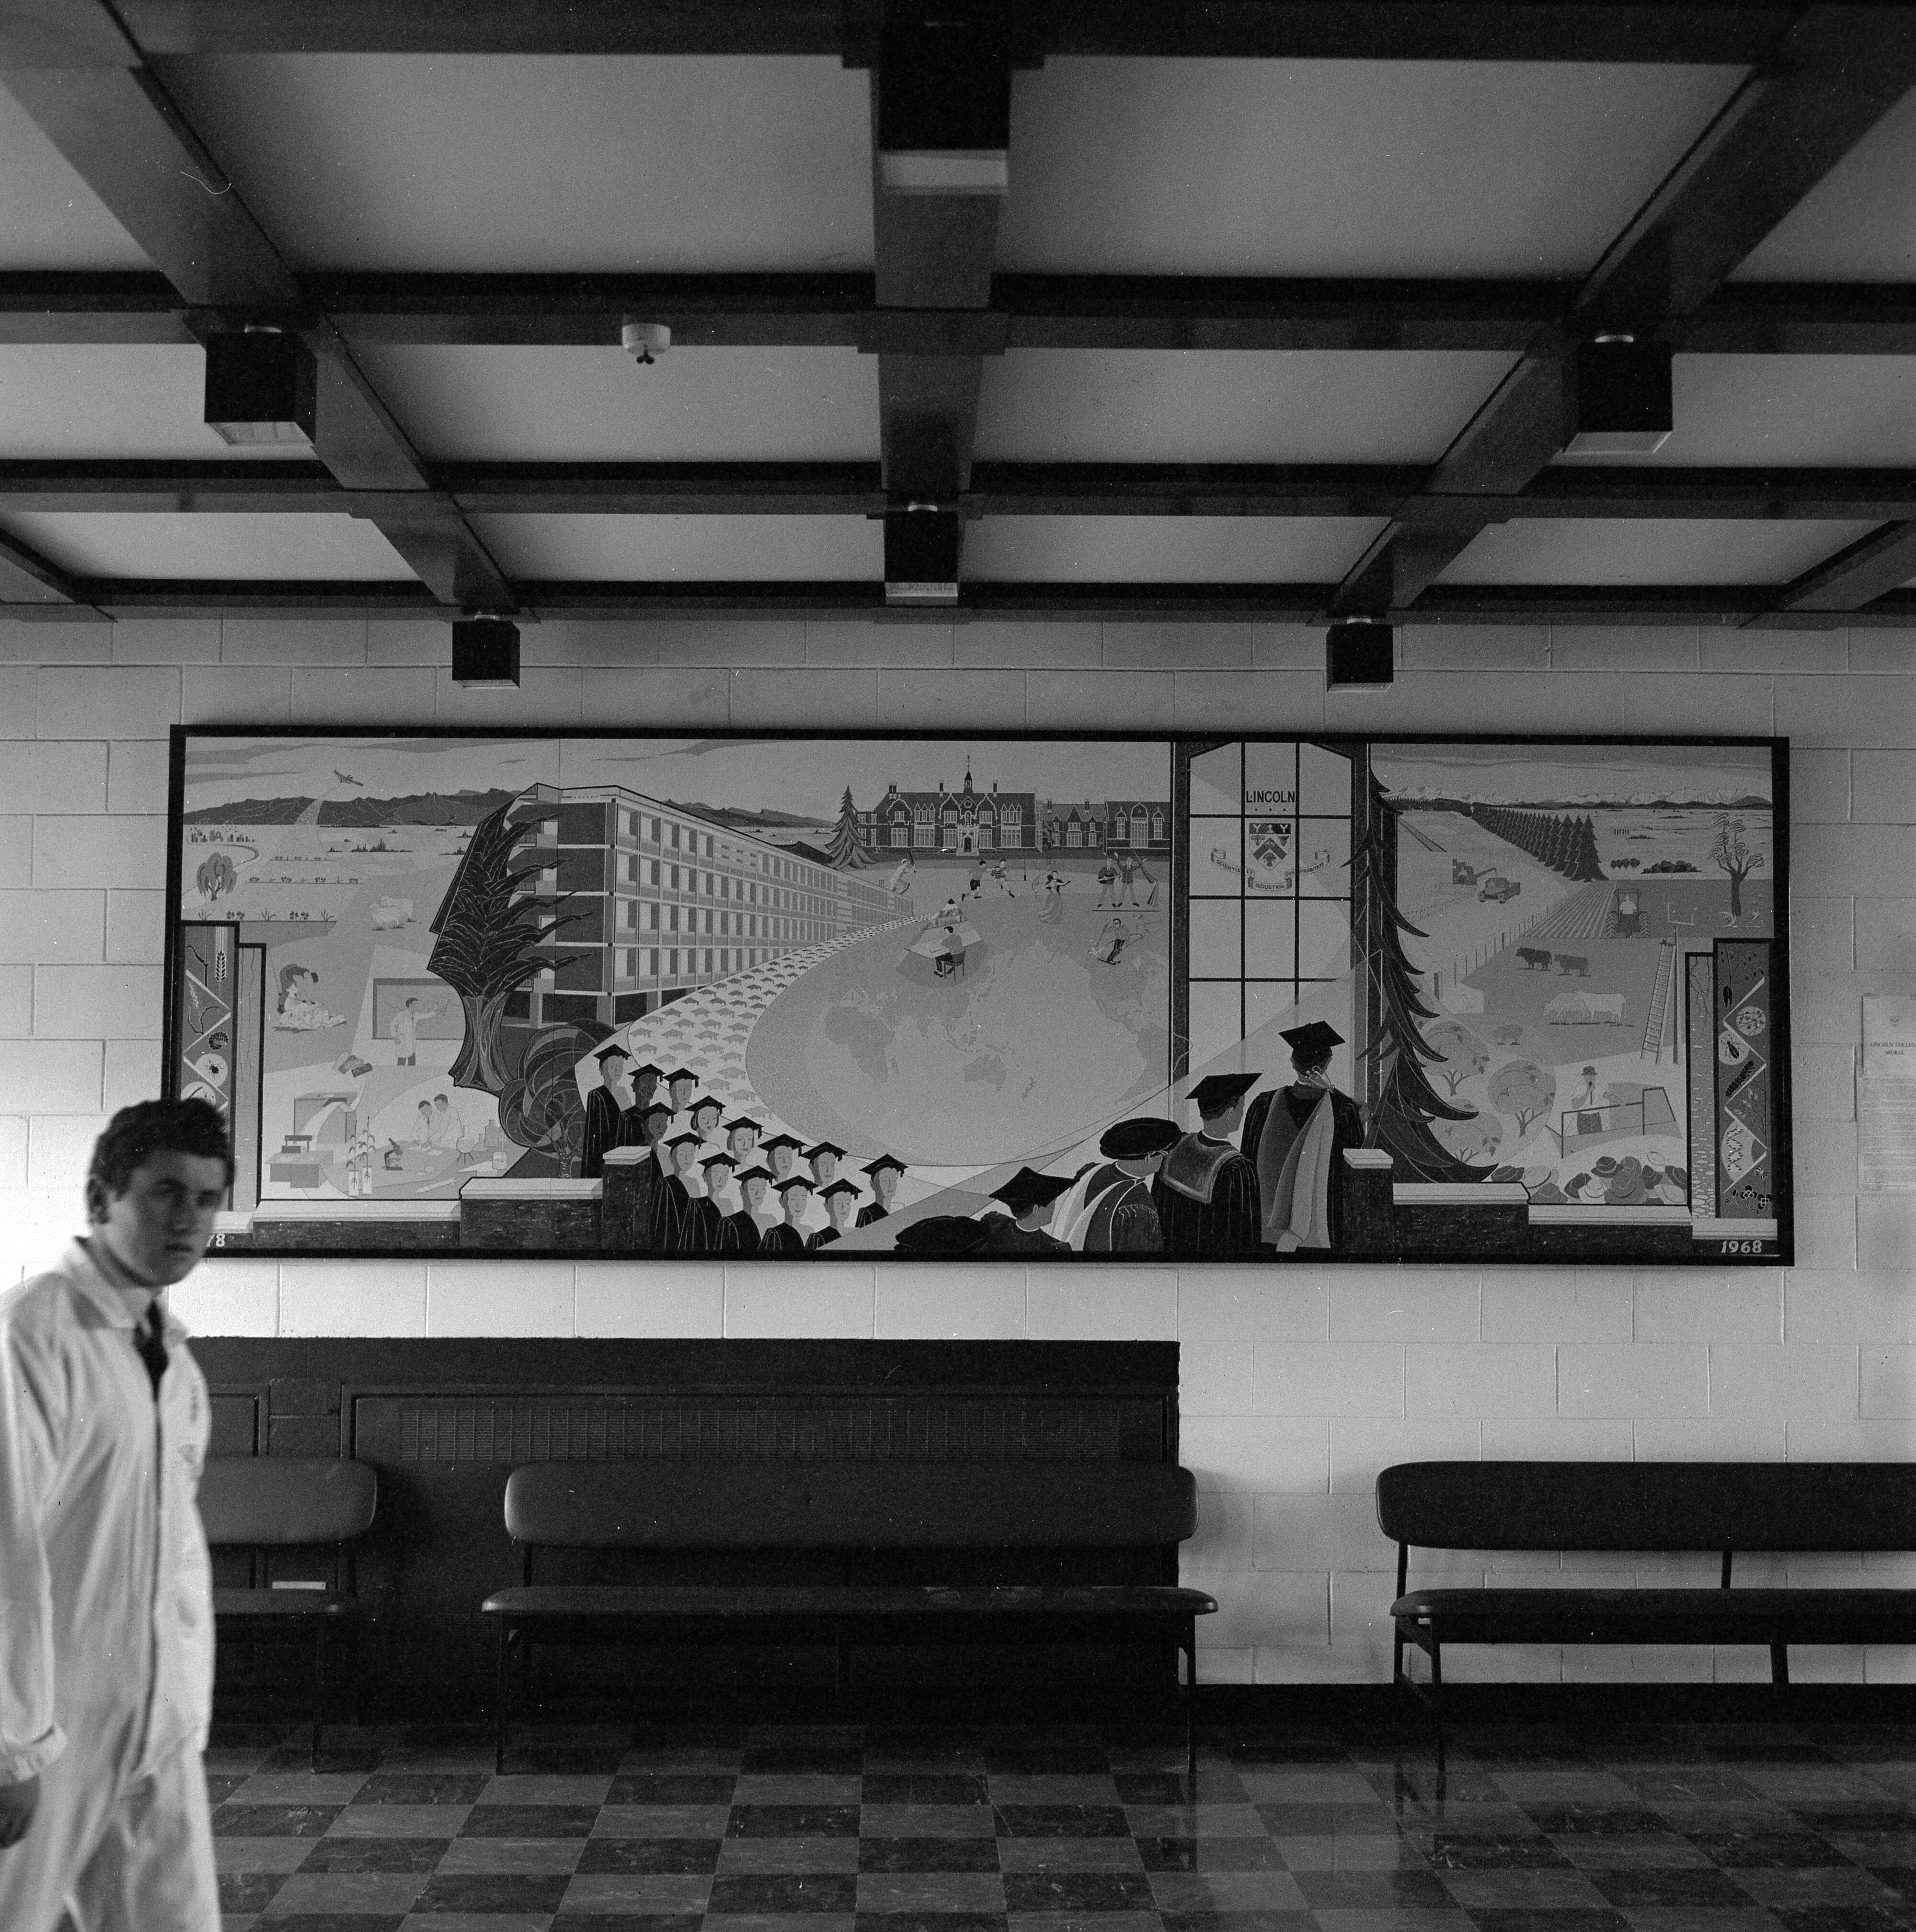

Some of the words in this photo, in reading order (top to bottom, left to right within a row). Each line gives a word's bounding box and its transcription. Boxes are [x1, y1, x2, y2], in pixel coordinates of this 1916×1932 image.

[1246, 791, 1295, 802] LINCOLN
[1216, 859, 1241, 873] SCIENTIA
[1300, 861, 1324, 874] PROBITATE
[1721, 1240, 1762, 1253] 1968
